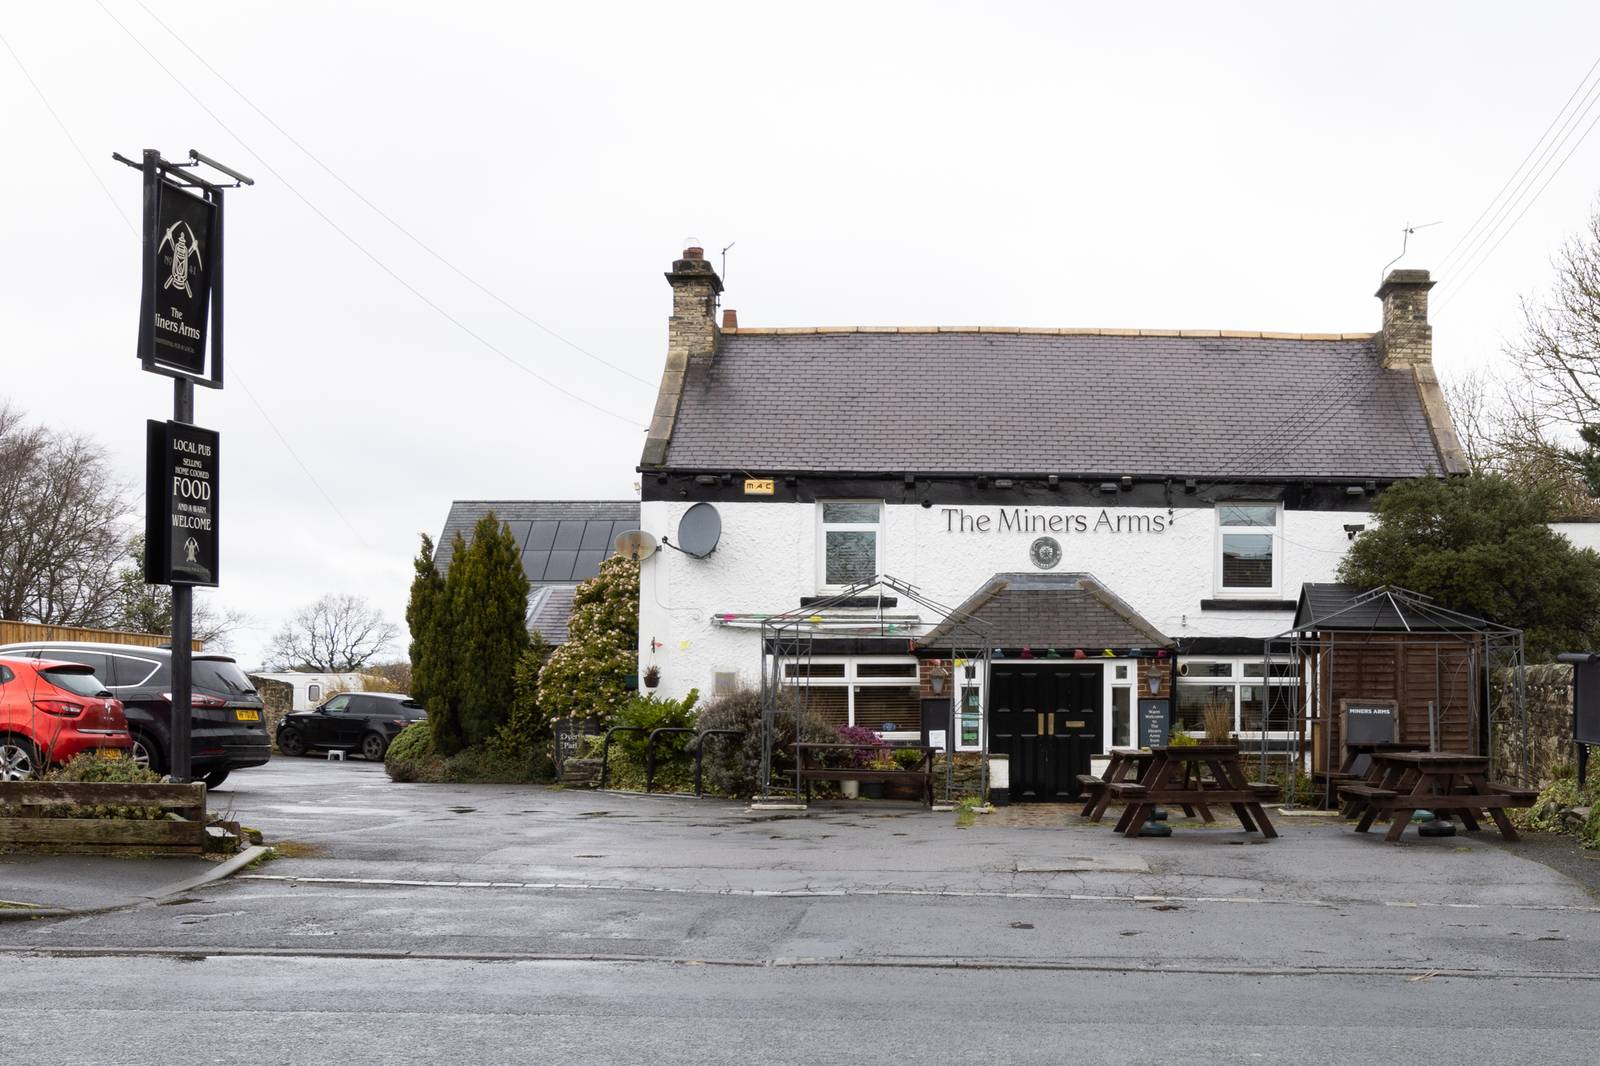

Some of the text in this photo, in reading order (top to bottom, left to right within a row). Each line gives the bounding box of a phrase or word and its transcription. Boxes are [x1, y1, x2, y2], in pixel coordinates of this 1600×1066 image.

[170, 306, 183, 320] The
[178, 321, 200, 340] Arms
[173, 438, 211, 457] LOCAL PUB
[182, 457, 202, 469] SELLING
[175, 466, 209, 479] HOME COOKED
[173, 476, 211, 501] FOOD
[178, 502, 188, 512] AND
[192, 505, 207, 514] WARM
[172, 514, 212, 531] WELCOME
[942, 508, 1166, 533] The Miners Arms
